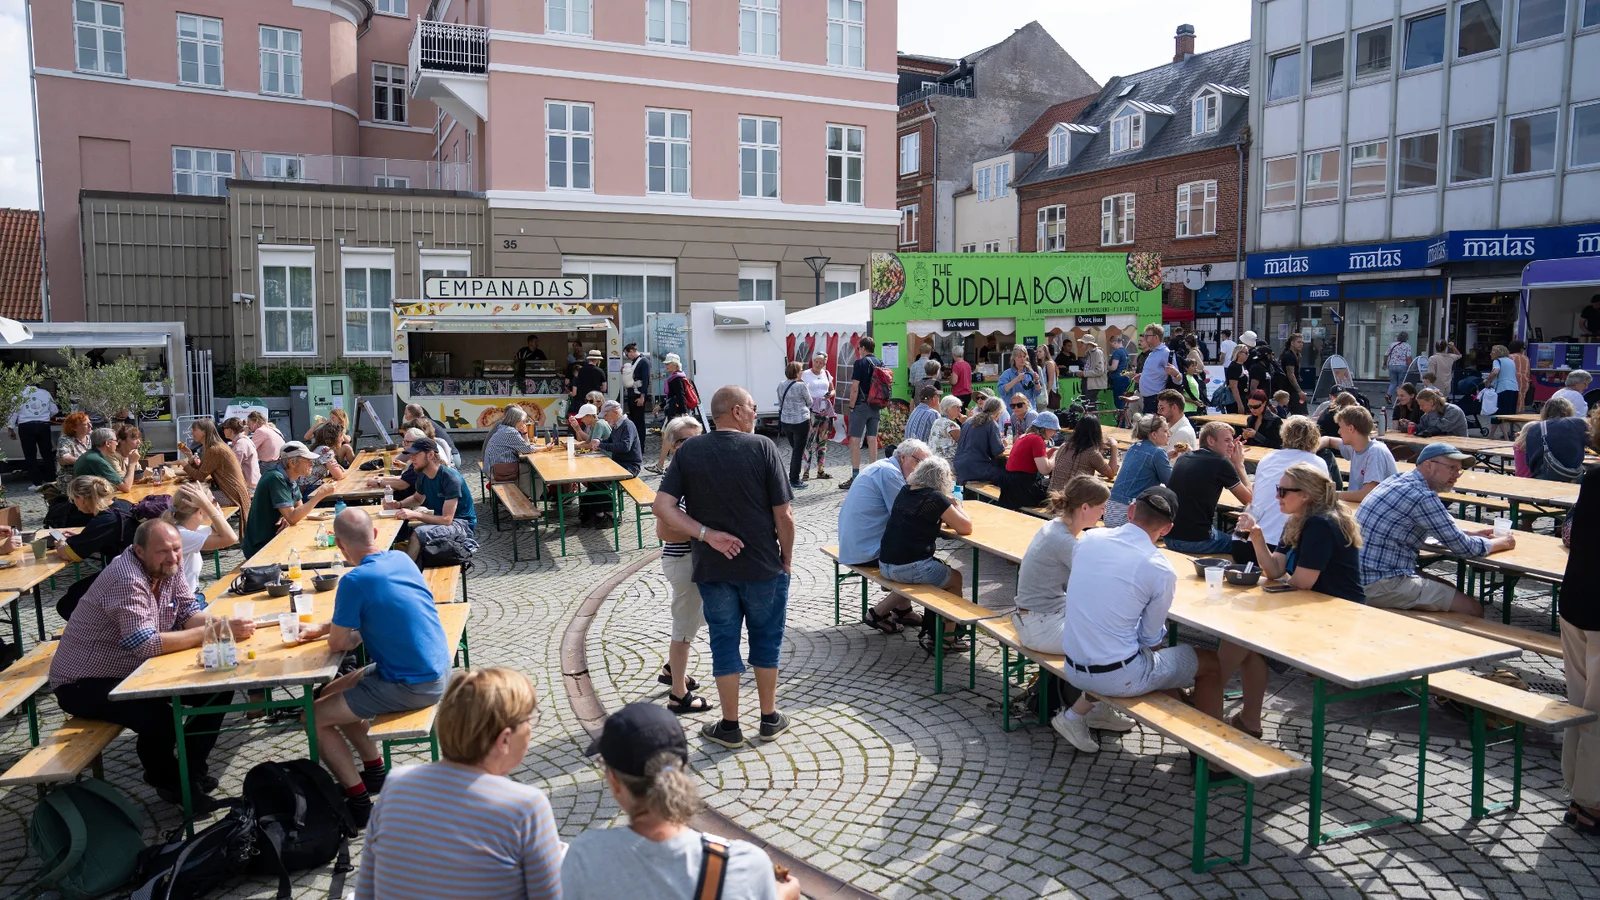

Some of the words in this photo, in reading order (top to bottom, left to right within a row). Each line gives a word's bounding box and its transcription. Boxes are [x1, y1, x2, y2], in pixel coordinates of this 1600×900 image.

[503, 240, 517, 249] 35
[1427, 239, 1447, 264] matas
[1463, 234, 1535, 257] matas
[1263, 254, 1309, 275] matas
[1349, 247, 1401, 269] matas
[932, 263, 953, 276] THE
[439, 280, 574, 297] EMPANADAS
[932, 277, 1028, 308] BUDDHA
[1033, 276, 1099, 305] BOWL
[1101, 290, 1140, 303] PROJECT
[1309, 289, 1330, 298] matas
[1390, 314, 1397, 324] 3
[1402, 314, 1409, 324] 2
[443, 378, 562, 395] EMPANADAS
